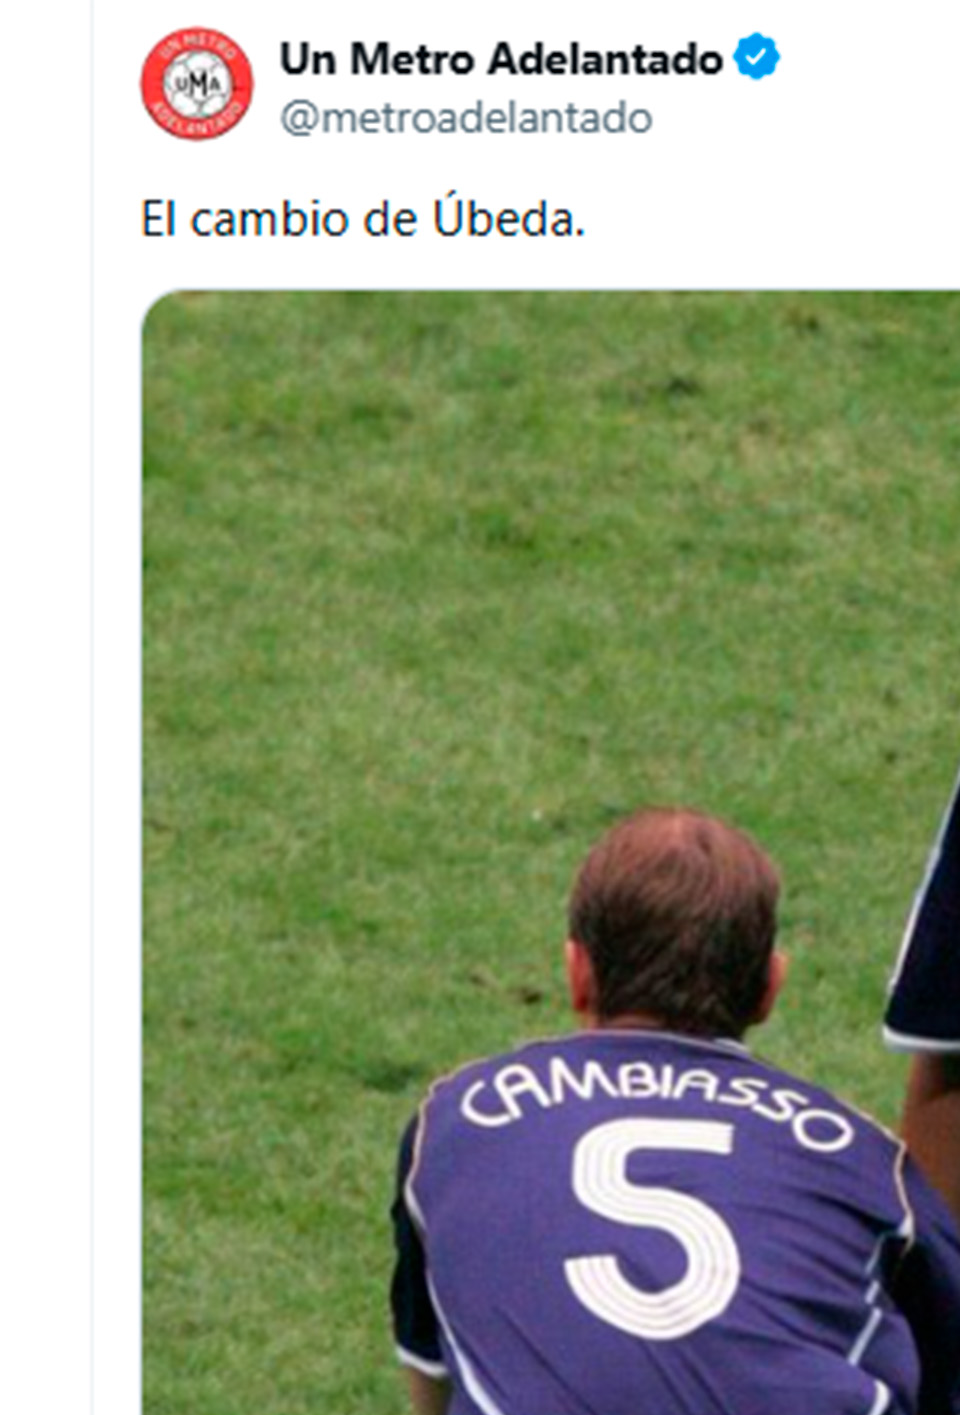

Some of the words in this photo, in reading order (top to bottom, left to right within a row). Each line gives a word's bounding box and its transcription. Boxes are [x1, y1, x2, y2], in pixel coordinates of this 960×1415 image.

[280, 41, 336, 75] Un
[351, 41, 475, 75] Metro
[486, 41, 724, 75] Adelantado
[174, 69, 222, 98] UMA
[281, 99, 652, 136] @metroadelantado
[143, 199, 175, 237] El
[191, 199, 349, 237] cambio
[364, 199, 417, 237] de
[435, 189, 584, 237] Úbeda.
[461, 1057, 854, 1152] CAMBIASSO
[564, 1118, 740, 1340] 5
